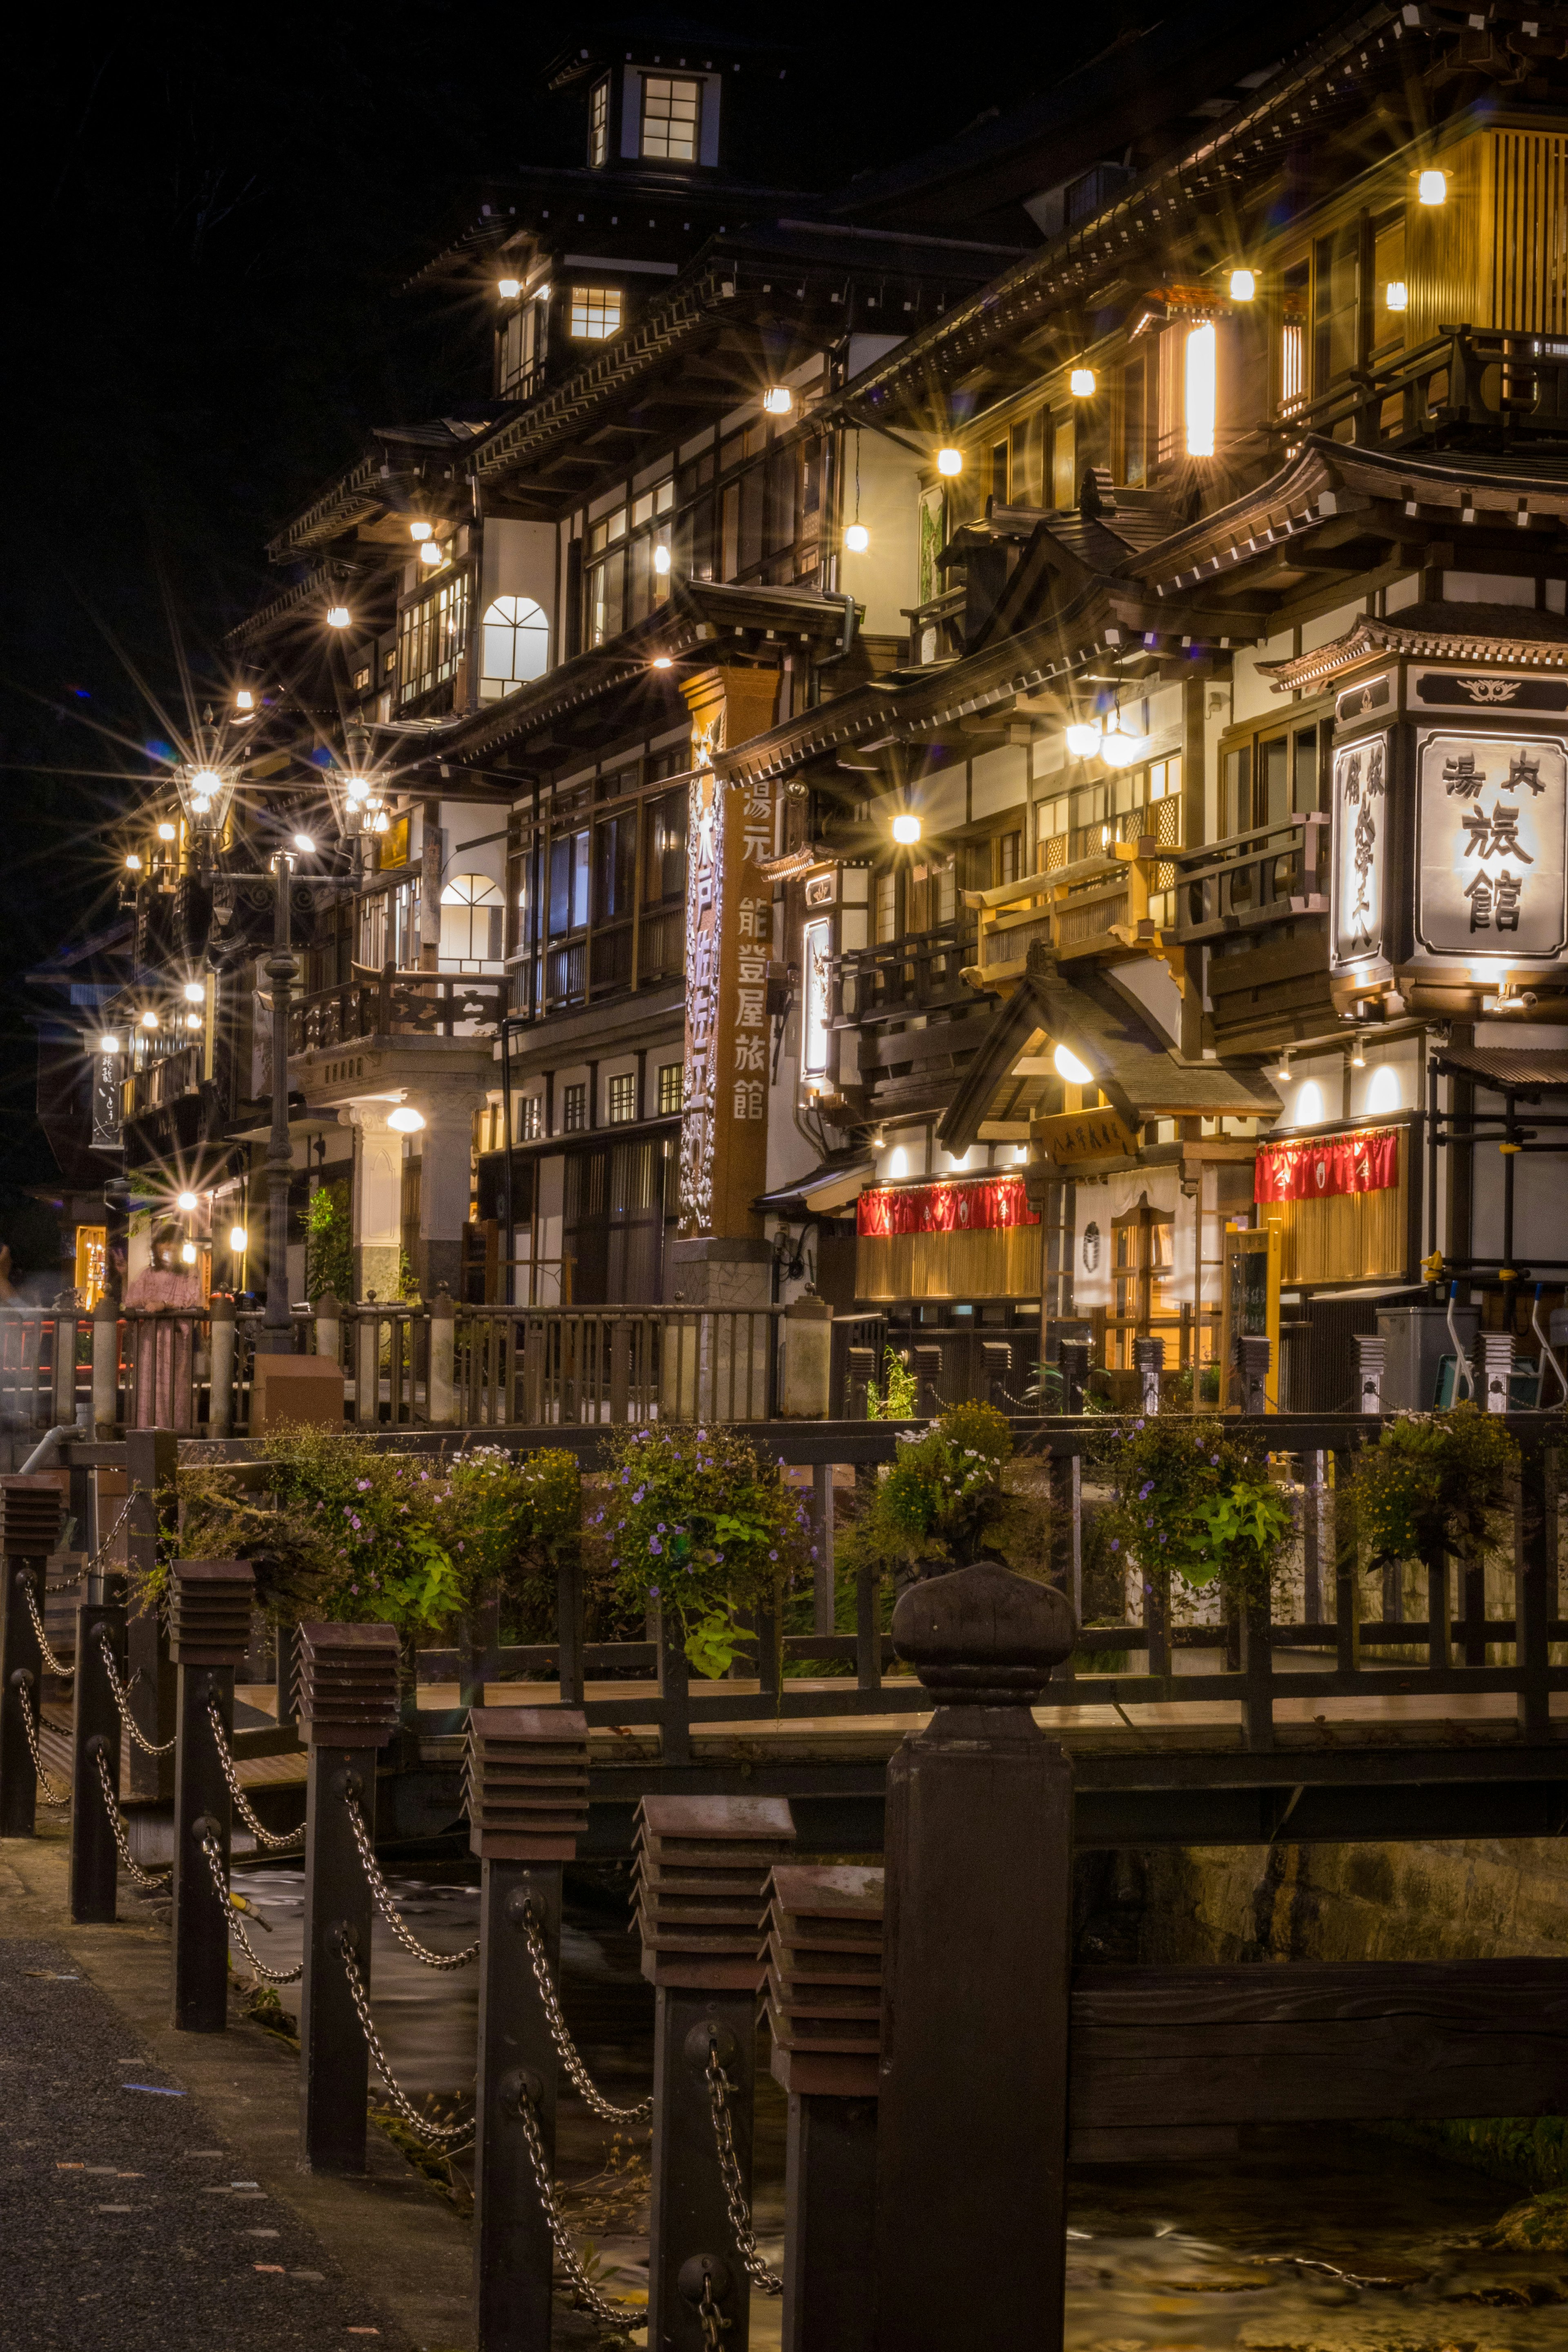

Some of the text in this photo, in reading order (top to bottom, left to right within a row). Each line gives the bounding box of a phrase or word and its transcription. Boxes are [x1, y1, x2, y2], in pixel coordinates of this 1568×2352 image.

[1442, 749, 1546, 799] 内湯
[1461, 800, 1534, 933] 旅館
[733, 781, 772, 1120] 湯元 能登屋旅館
